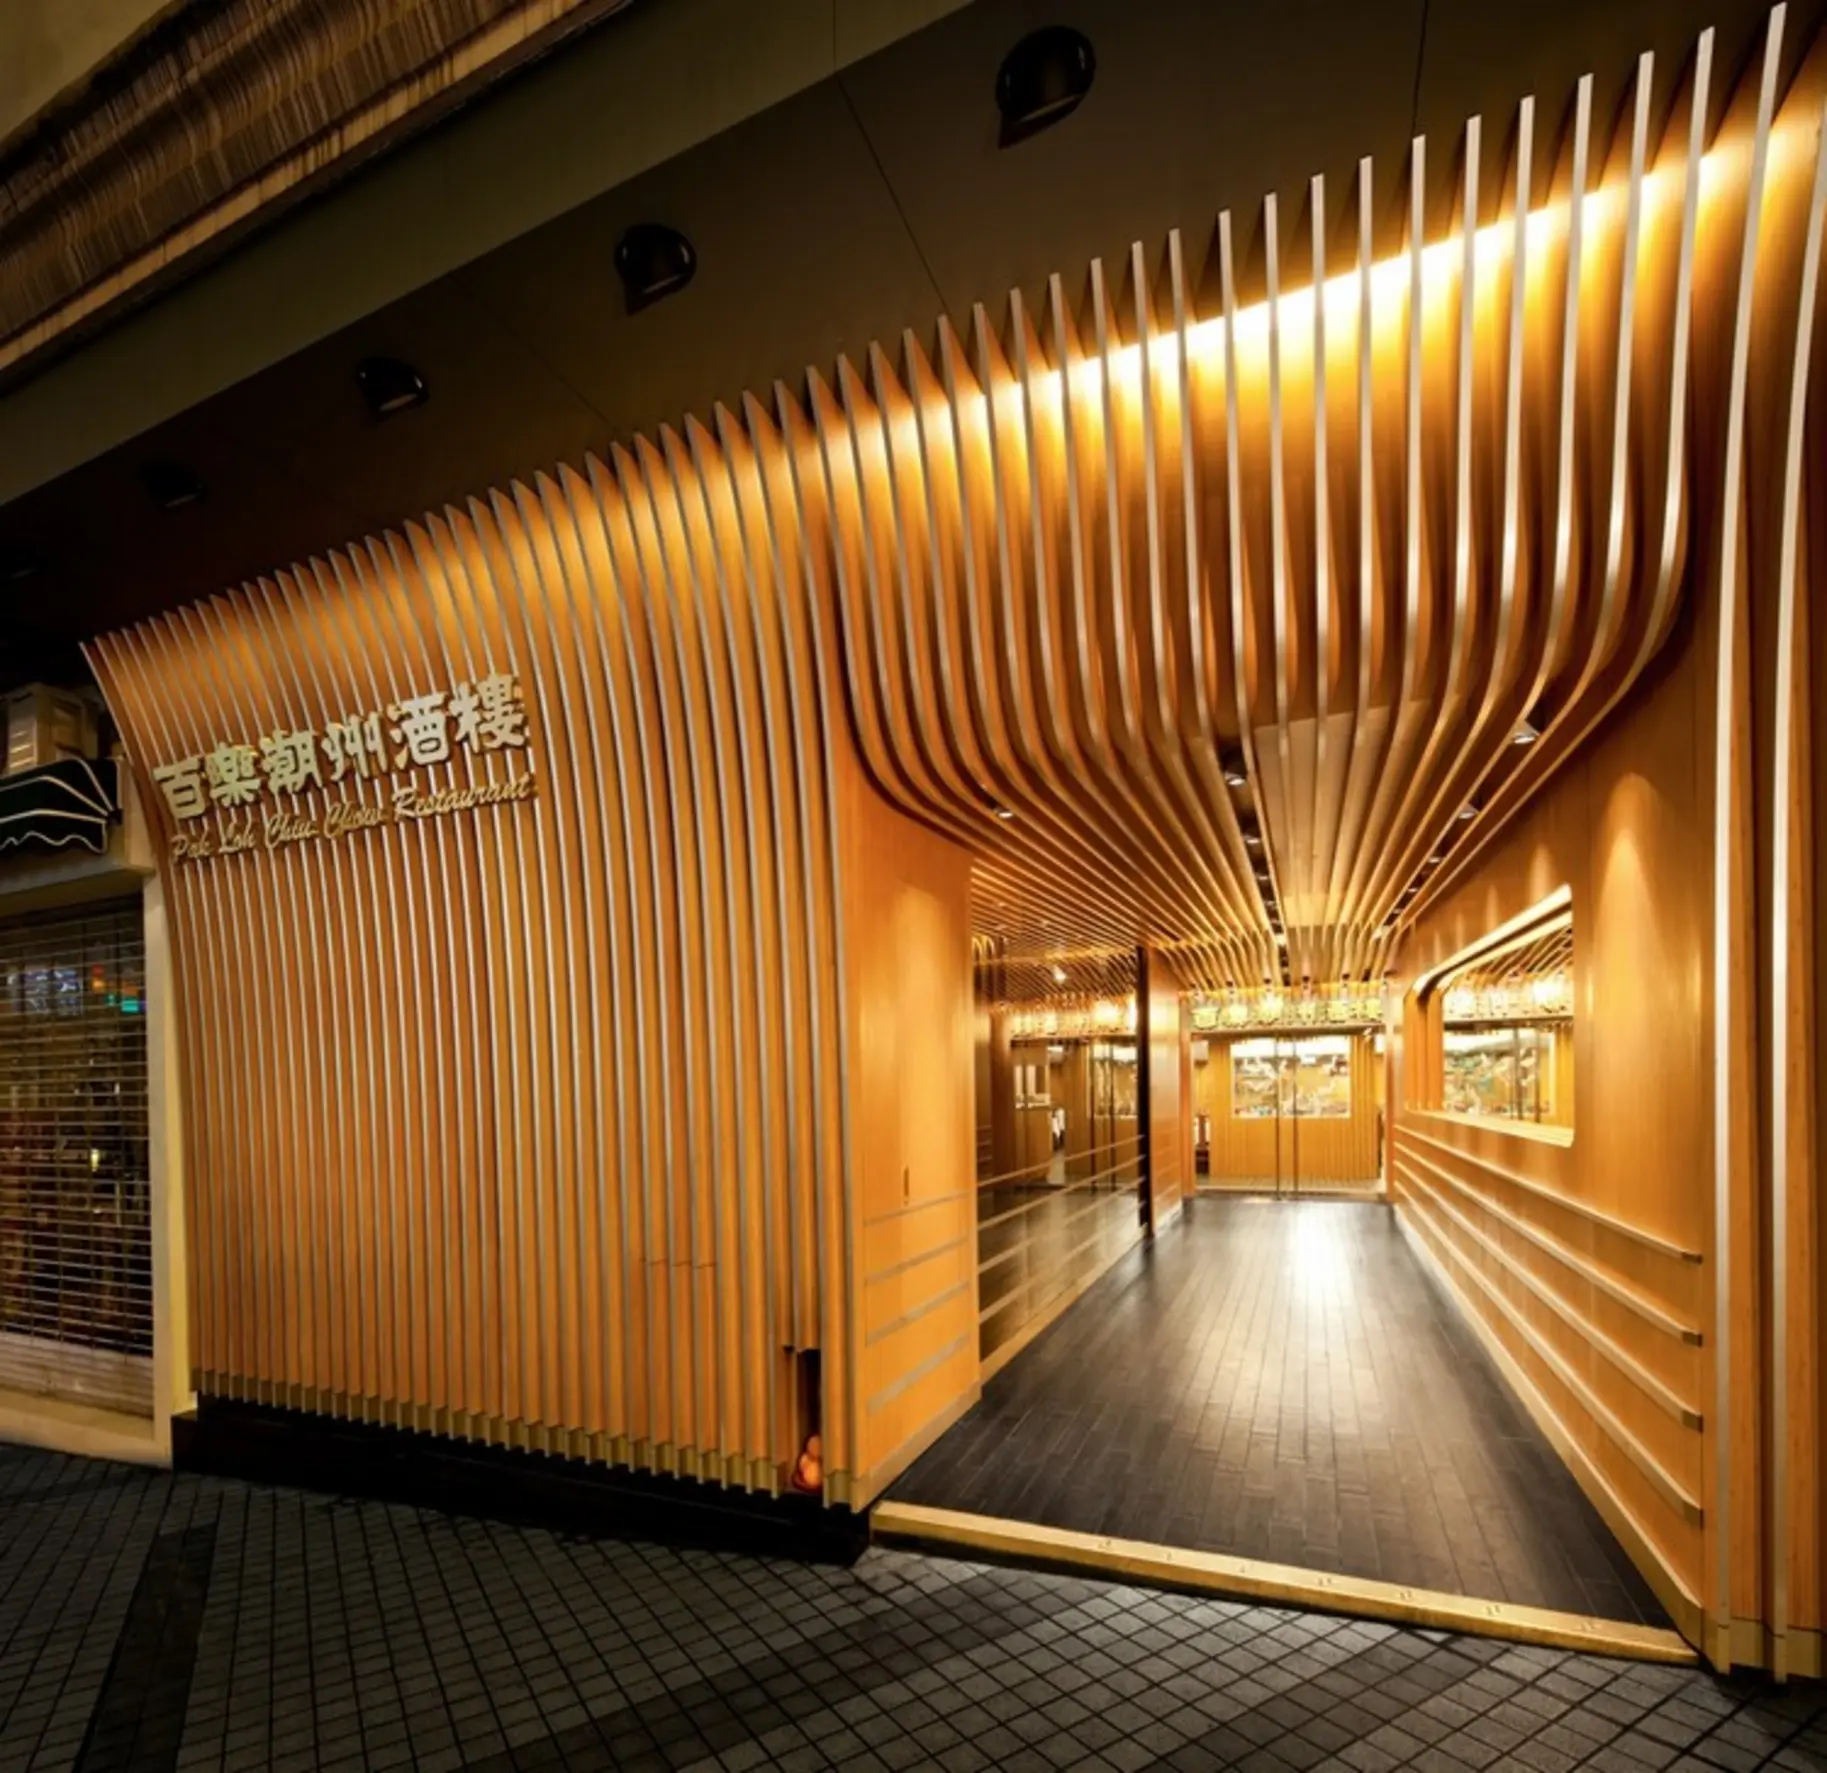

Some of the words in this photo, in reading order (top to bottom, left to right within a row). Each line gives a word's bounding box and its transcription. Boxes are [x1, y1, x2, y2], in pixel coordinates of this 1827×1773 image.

[153, 671, 527, 820] 百樂潮州酒樓
[265, 812, 318, 848] Chiu
[324, 800, 387, 838] Chow
[392, 772, 536, 822] Restaurant
